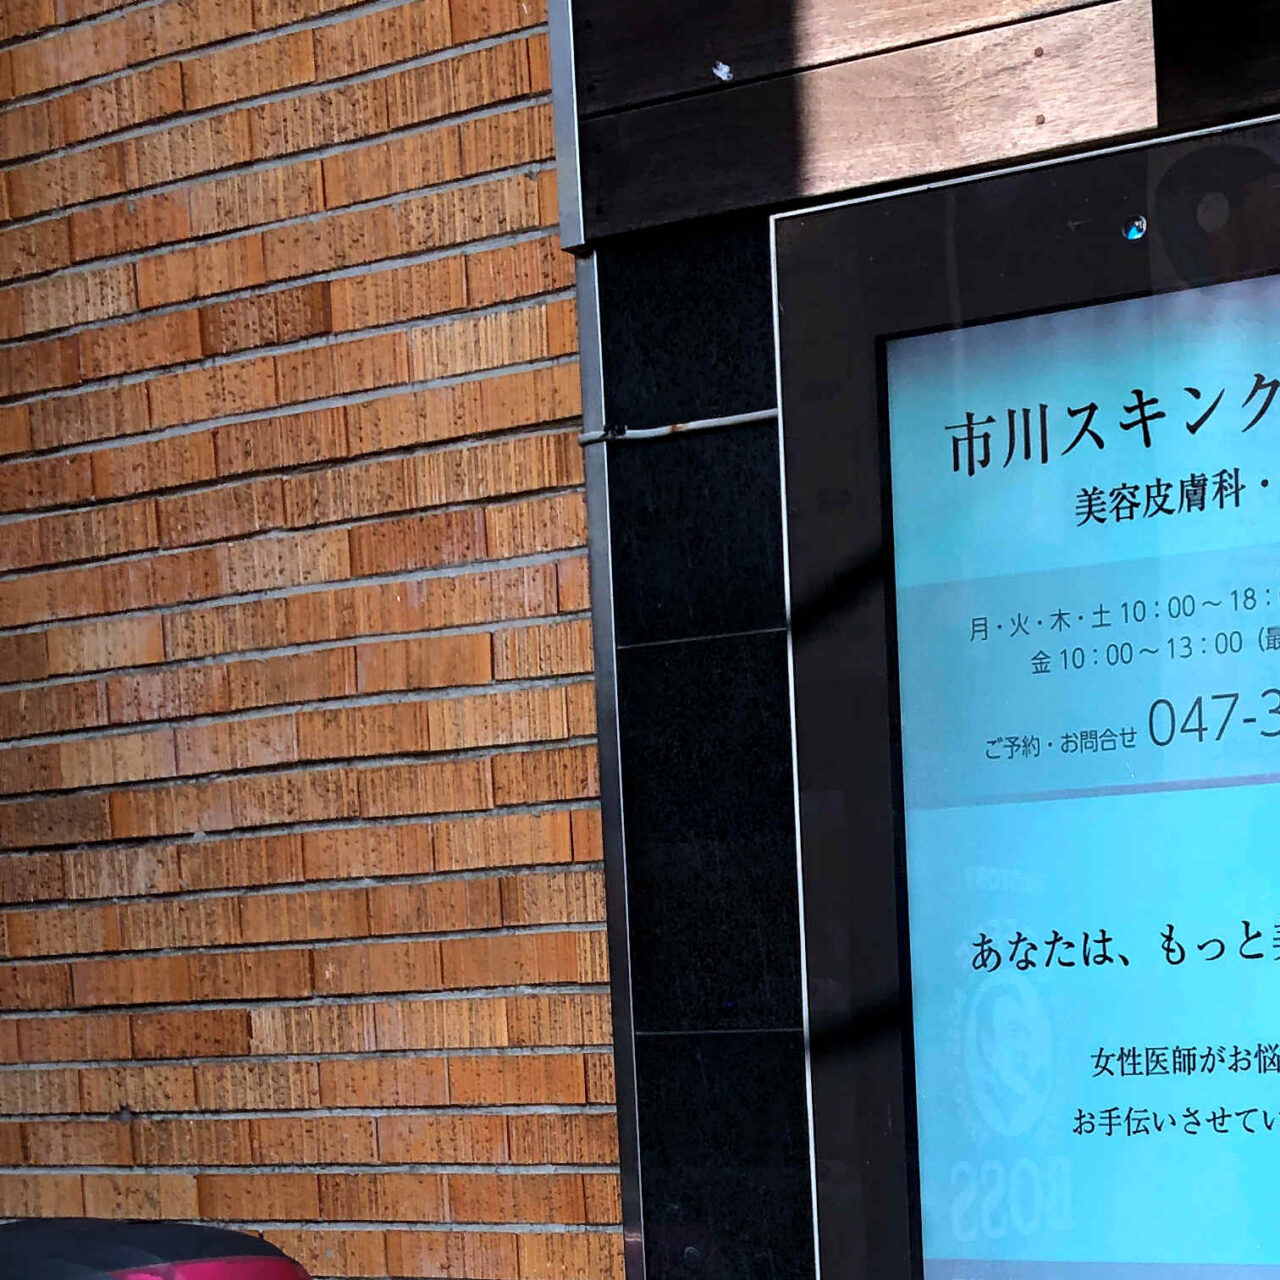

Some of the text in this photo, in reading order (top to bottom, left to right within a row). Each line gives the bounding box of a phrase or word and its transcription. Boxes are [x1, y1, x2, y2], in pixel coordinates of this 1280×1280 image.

[985, 727, 1138, 760] ご予約・お問合せ
